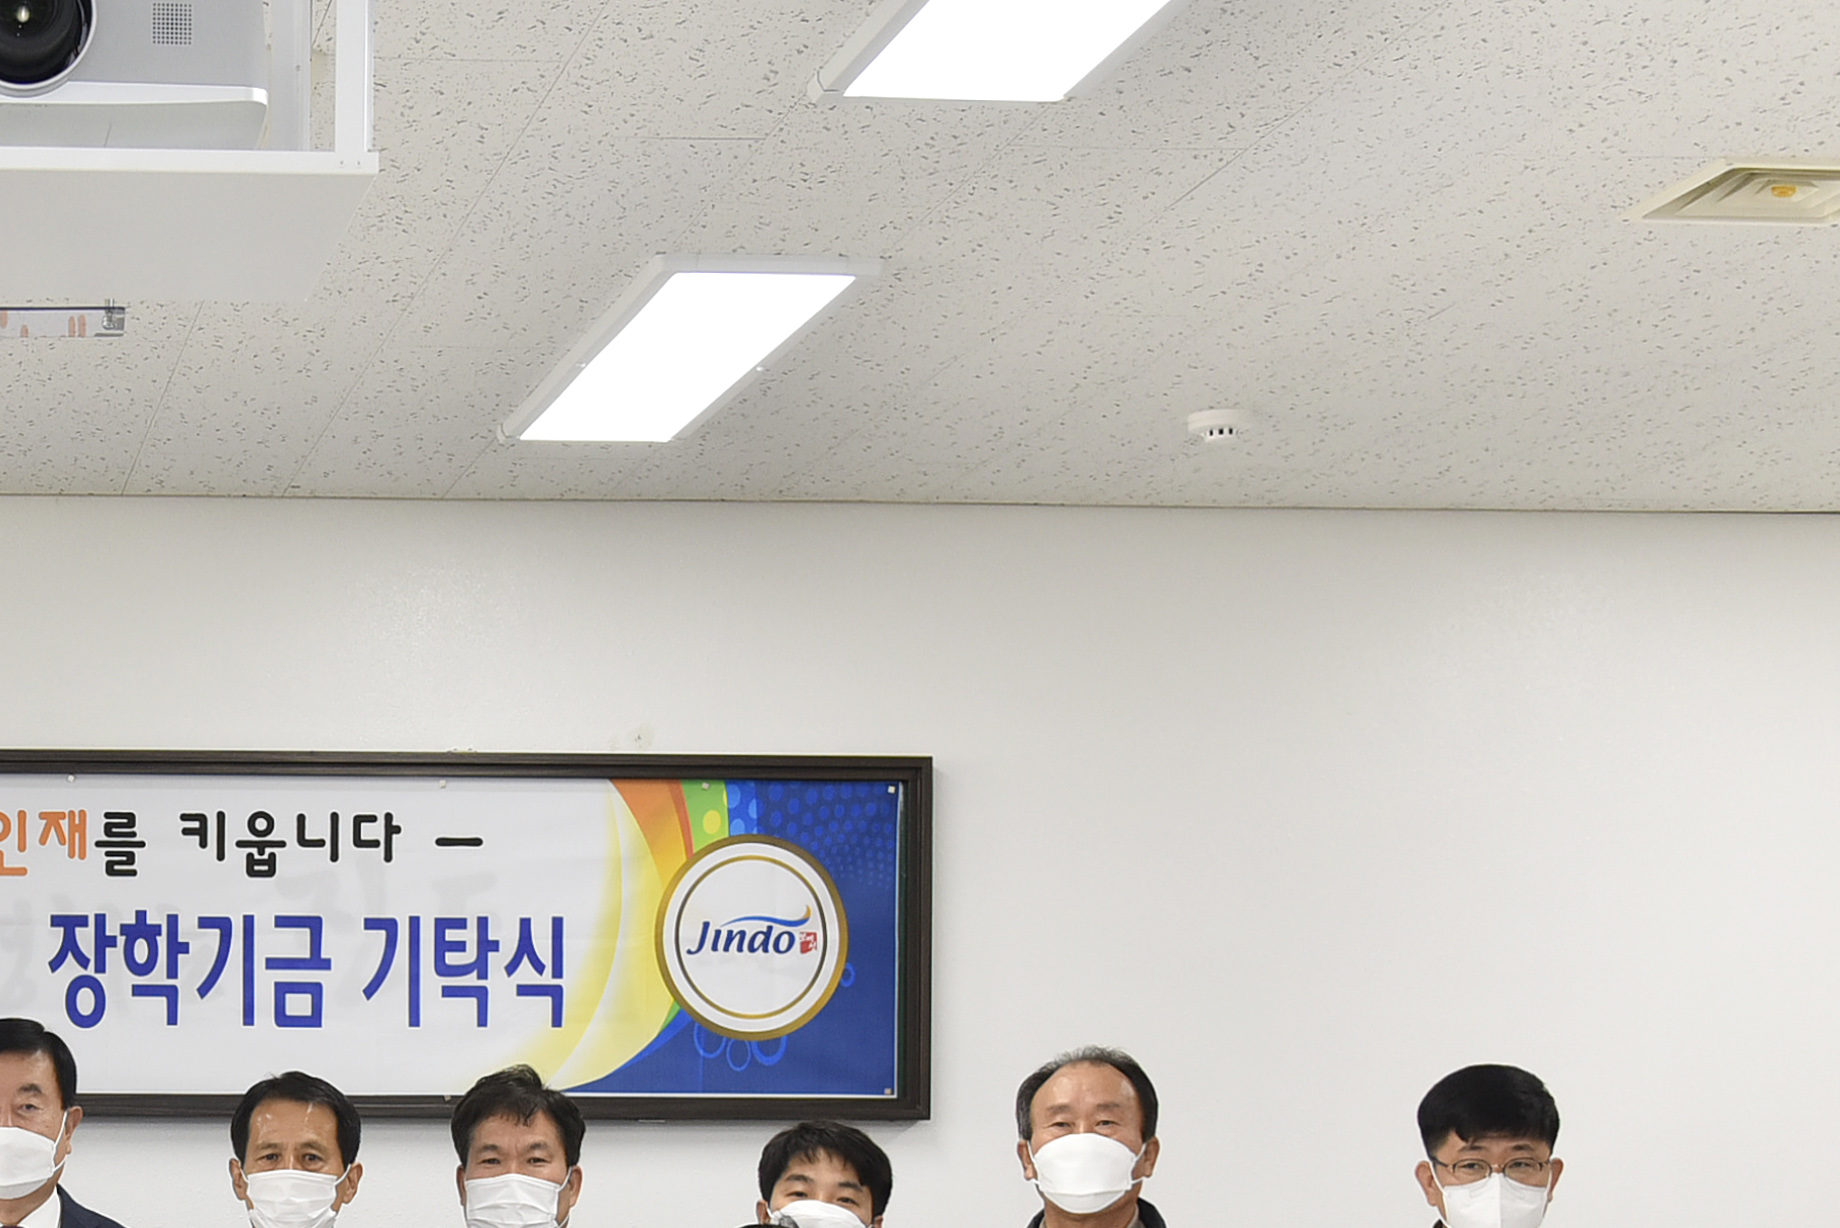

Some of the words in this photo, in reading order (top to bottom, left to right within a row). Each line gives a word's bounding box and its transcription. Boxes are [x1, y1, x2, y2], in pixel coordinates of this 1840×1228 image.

[180, 811, 401, 878] 키웁니다
[686, 921, 795, 955] Jindo
[42, 910, 331, 1034] 장학기금
[362, 916, 570, 1034] 기탁식
